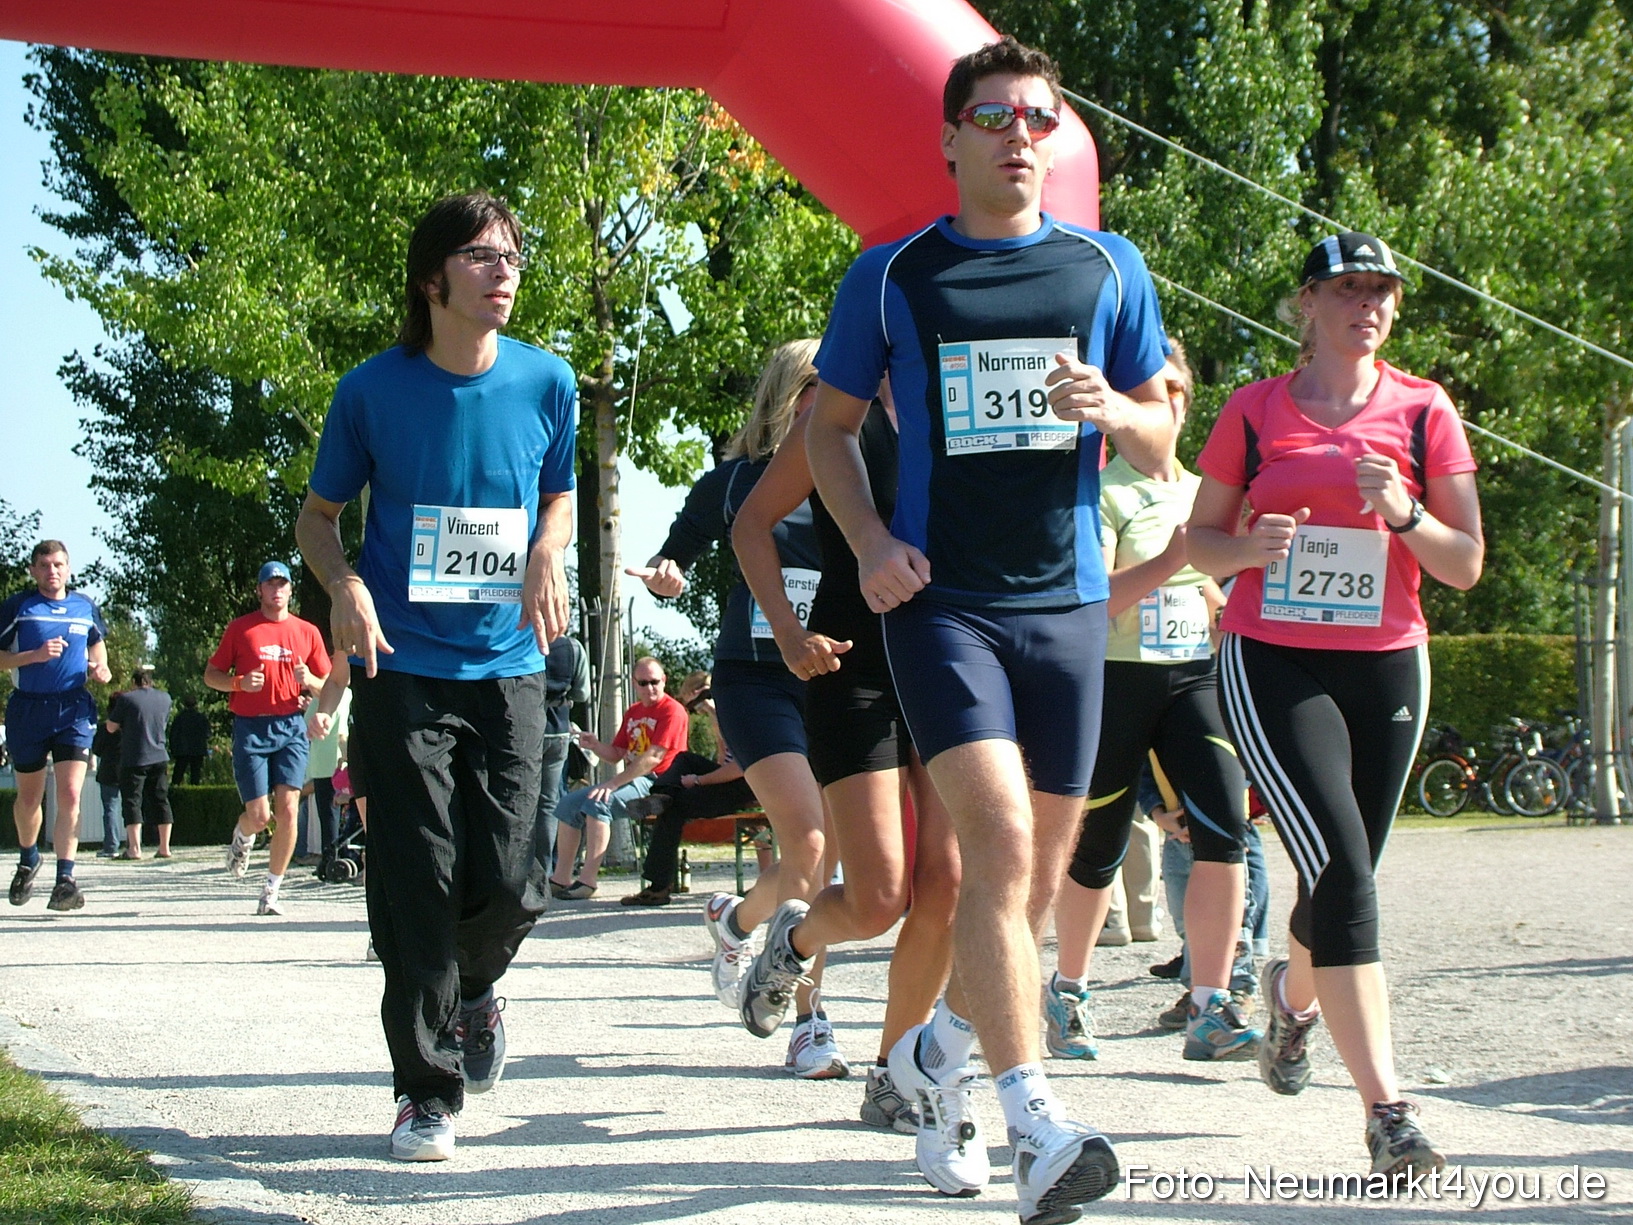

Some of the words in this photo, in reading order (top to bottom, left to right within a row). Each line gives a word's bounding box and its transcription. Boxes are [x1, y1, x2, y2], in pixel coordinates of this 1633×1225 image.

[978, 352, 1047, 372] Norman
[948, 387, 957, 402] D
[984, 389, 1048, 419] 319
[949, 434, 998, 450] BOCK
[447, 516, 500, 536] Vincent
[416, 543, 425, 556] D
[1299, 534, 1339, 558] Tanja
[444, 550, 518, 577] 2104
[1270, 561, 1278, 575] D
[480, 588, 522, 598] PFLEIDERER
[1298, 569, 1375, 600] 2738
[1144, 615, 1151, 626] D
[998, 1073, 1017, 1091] TECH
